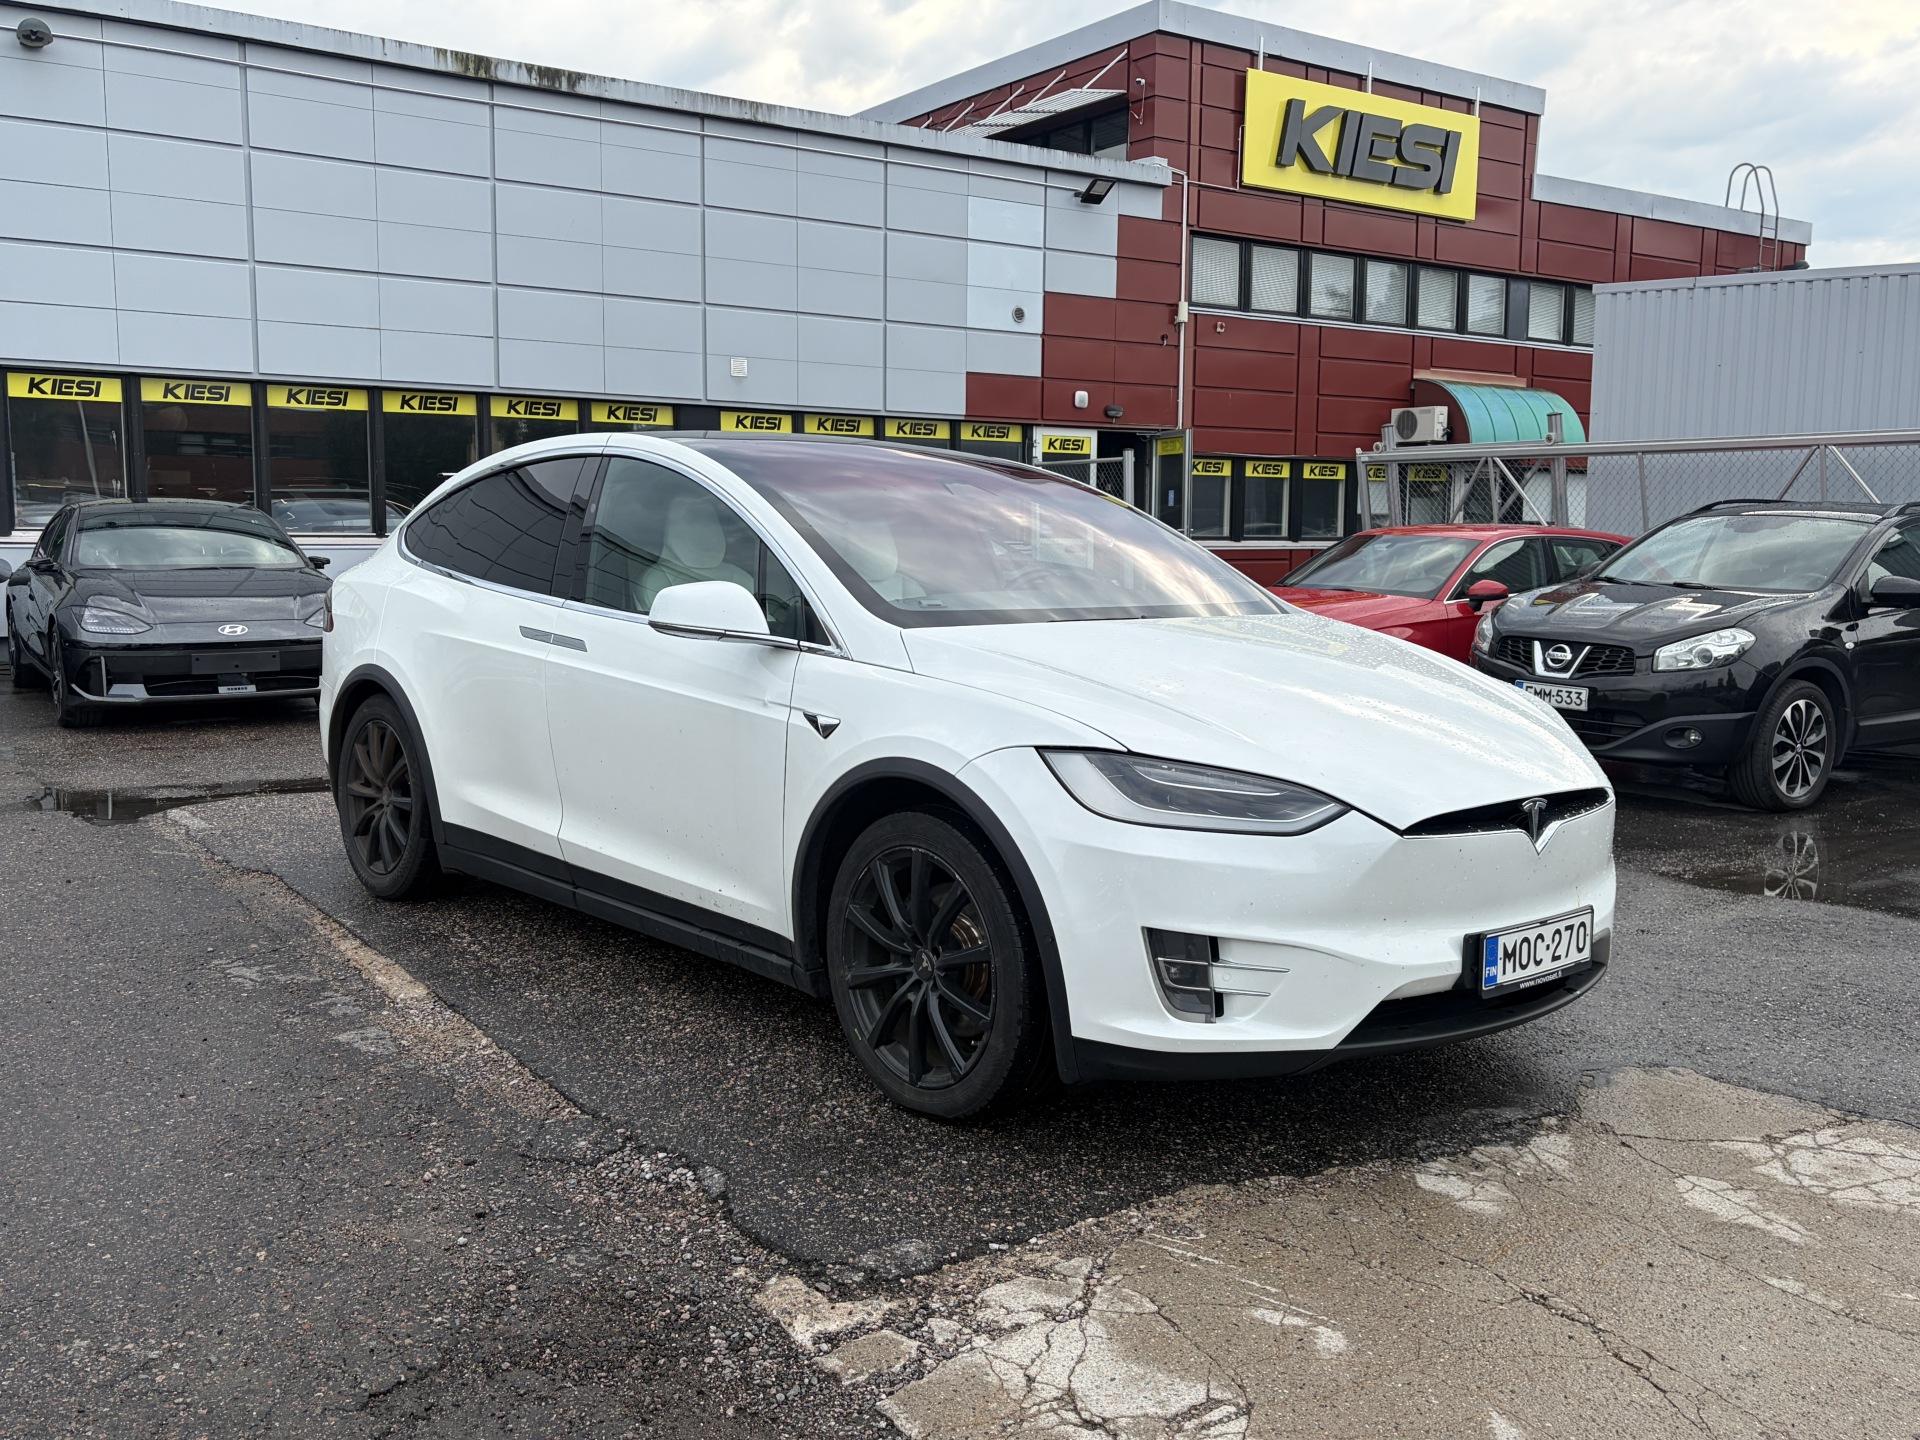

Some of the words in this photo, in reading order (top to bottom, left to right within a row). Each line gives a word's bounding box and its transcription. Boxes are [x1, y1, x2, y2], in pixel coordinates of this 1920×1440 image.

[1276, 98, 1462, 195] KIESI
[28, 377, 102, 398] KIESI
[163, 383, 231, 402] KIESI
[286, 388, 349, 407] KIESI
[400, 394, 458, 412] KIESI
[507, 400, 562, 417] KIESI
[607, 405, 658, 422] KIESI
[735, 415, 782, 431] KIESI
[817, 417, 861, 433] KIESI
[896, 422, 937, 437] KIESI
[971, 424, 1010, 439] KIESI
[1048, 438, 1085, 452] KIESI
[1192, 461, 1225, 474] KIESI
[1252, 463, 1284, 476] KIESI
[1309, 465, 1339, 477] KIESI
[1502, 921, 1587, 976] MOC-270
[1485, 965, 1497, 978] FIN
